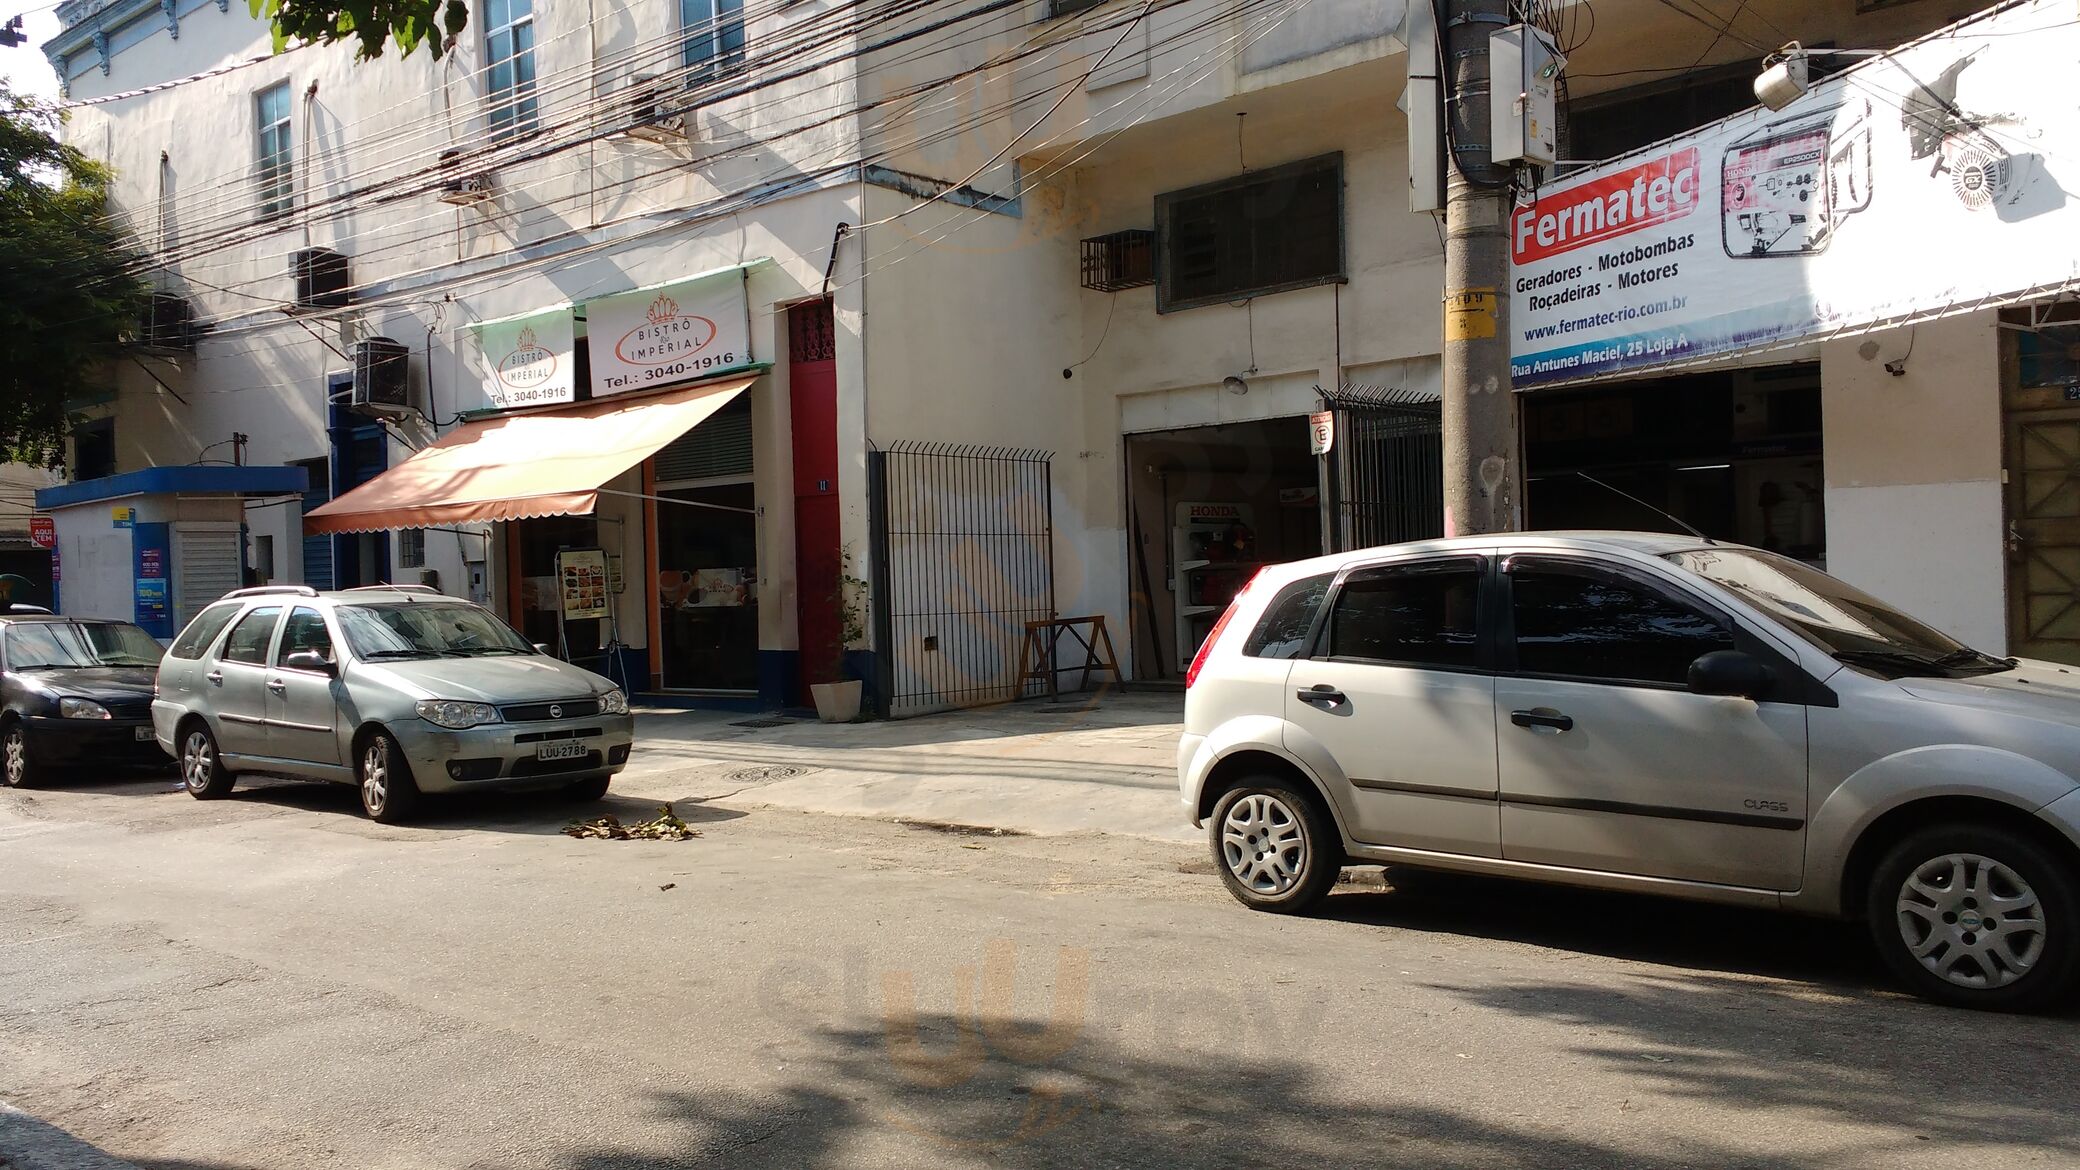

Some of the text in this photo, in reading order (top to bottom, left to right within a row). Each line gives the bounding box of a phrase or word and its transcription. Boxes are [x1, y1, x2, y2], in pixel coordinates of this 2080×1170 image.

[1516, 167, 1693, 254] Fermatec
[1516, 264, 1582, 293] Geradores
[1598, 233, 1695, 272] Motobombas
[1529, 282, 1601, 311] Roçadeiras
[1618, 262, 1679, 290] Motores
[638, 318, 692, 341] BISTRÔ
[1524, 295, 1688, 342] www.fermatec-rio.com.br
[511, 349, 543, 365] BISTRÔ
[631, 337, 702, 361] IMPERIAL
[1511, 333, 1688, 378] Rua Antunes Maciel, 25 Loja A
[507, 368, 549, 382] IMPERIAL
[604, 352, 734, 389] Tel.: 3040-1916
[514, 386, 567, 402] 3040-1916
[1191, 505, 1240, 516] HONDA
[36, 534, 53, 542] TEM
[1744, 798, 1789, 812] CLASS
